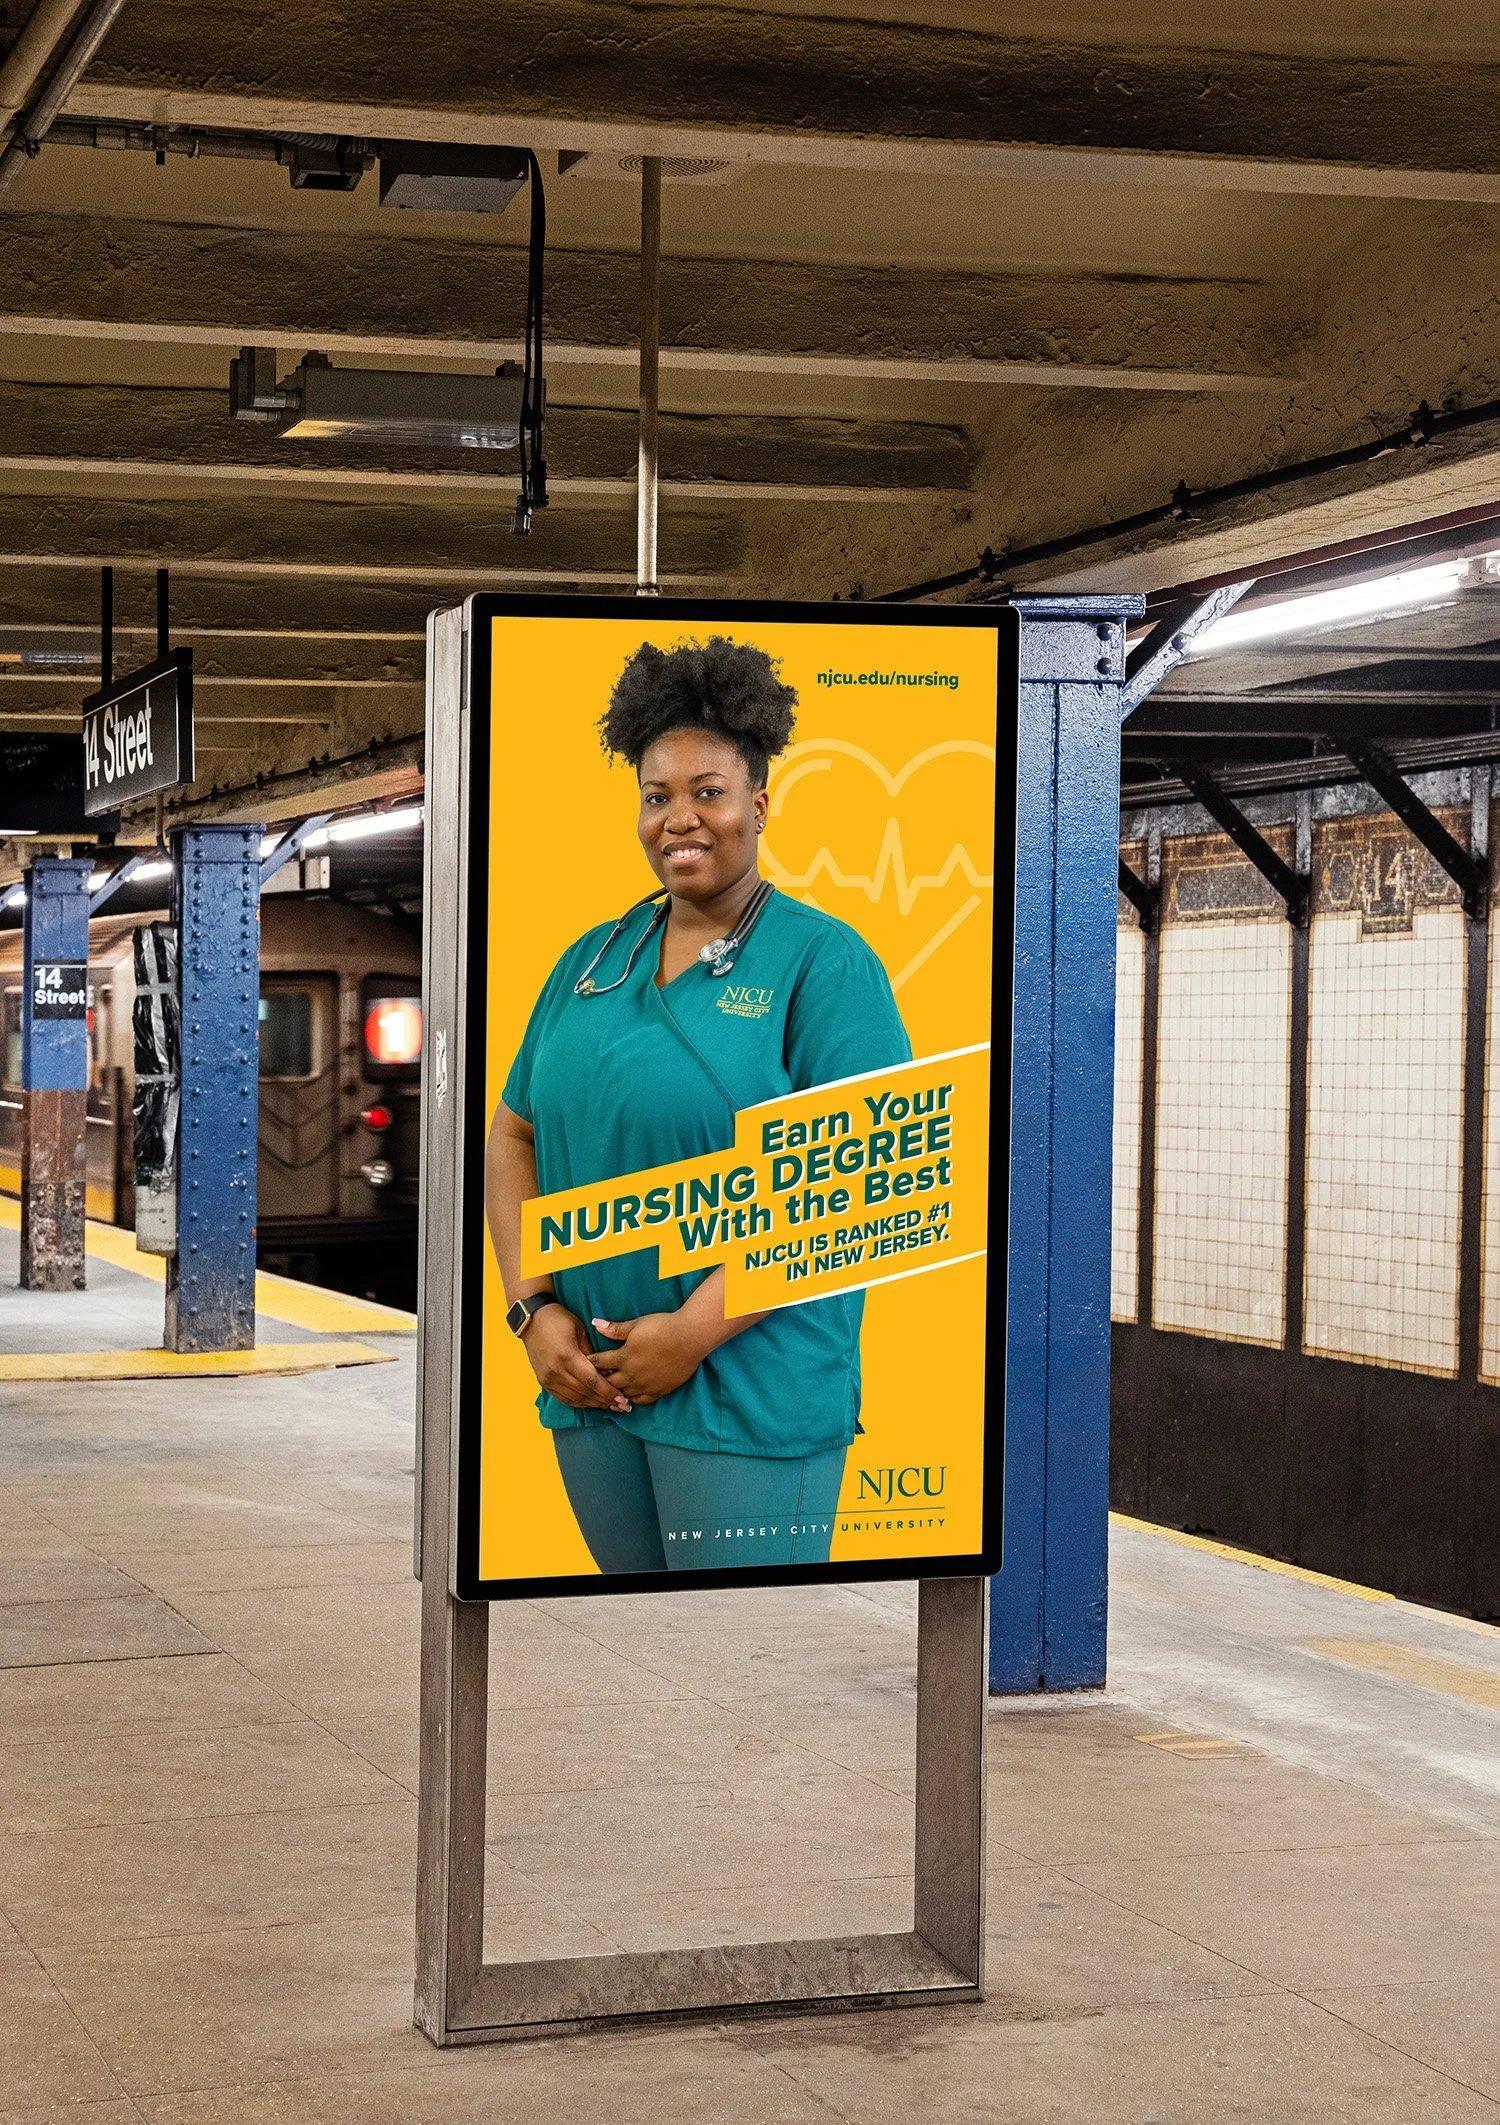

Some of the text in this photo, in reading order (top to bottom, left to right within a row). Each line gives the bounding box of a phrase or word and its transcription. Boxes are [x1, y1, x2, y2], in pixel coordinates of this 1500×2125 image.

[817, 668, 960, 690] njcu.edu/nursing
[83, 688, 154, 790] 14 Street
[1373, 852, 1406, 901] 14
[34, 967, 63, 989] 14
[34, 989, 86, 1005] Street
[721, 985, 774, 1004] NJCU
[378, 1011, 405, 1053] 1
[762, 1084, 954, 1155] Earn Your
[540, 1114, 953, 1254] NURSING DEGREE
[678, 1156, 953, 1253] With the Best
[745, 1201, 952, 1271] NJCU IS RANKED #1
[786, 1222, 952, 1282] IN NEW JERSEY.
[856, 1465, 948, 1505] NJCU
[668, 1518, 947, 1541] NEW JERSEY CITY UNIVERSITY
